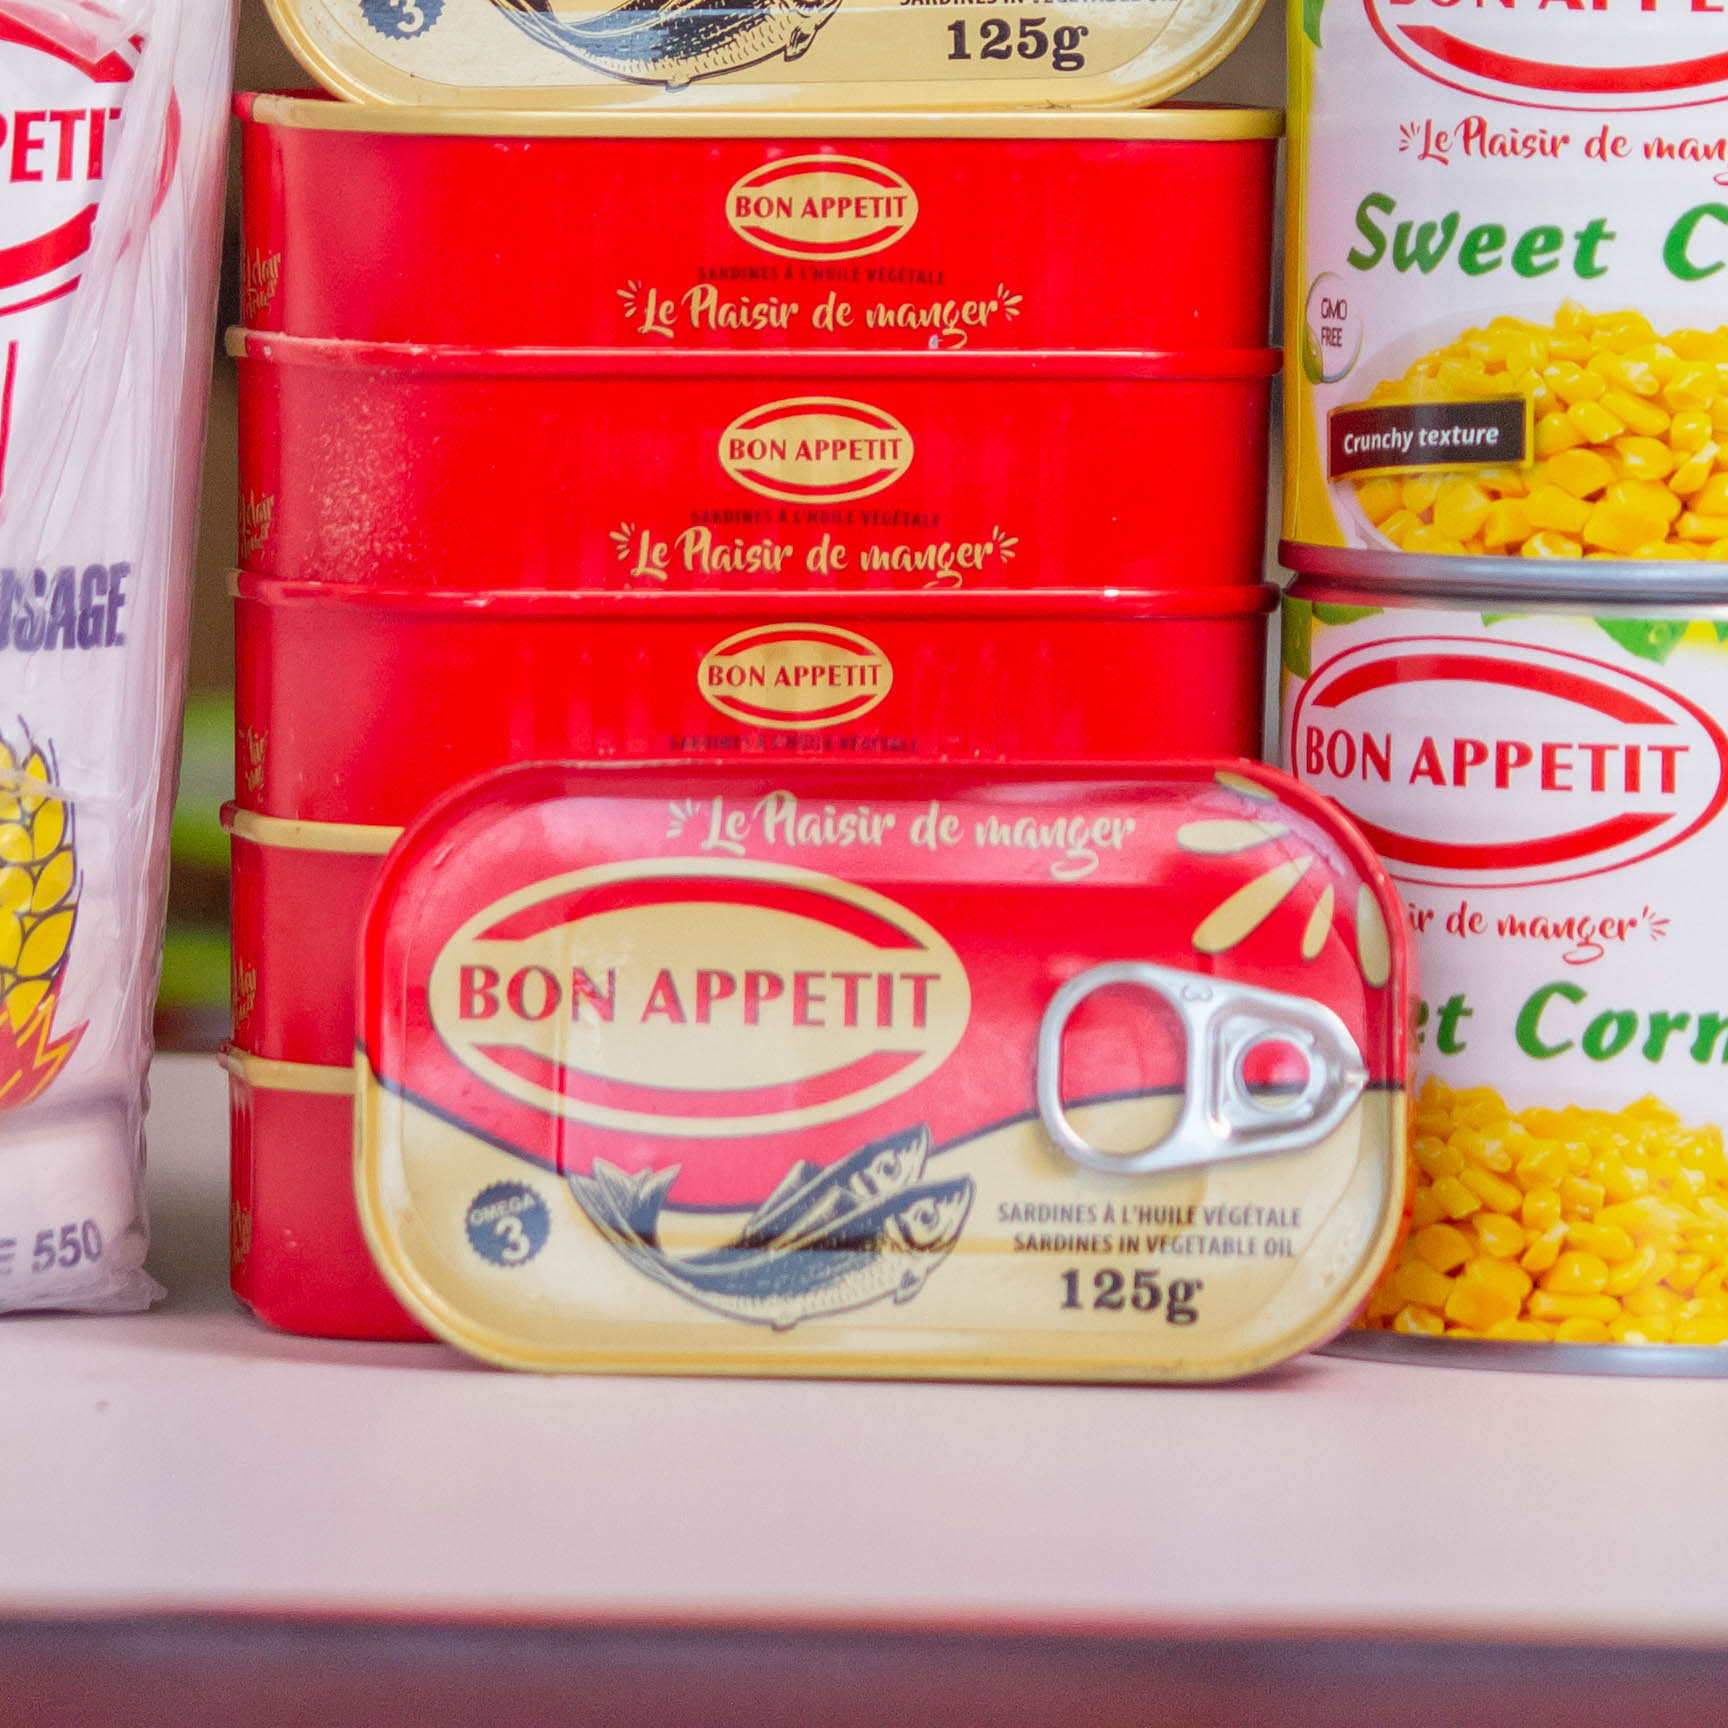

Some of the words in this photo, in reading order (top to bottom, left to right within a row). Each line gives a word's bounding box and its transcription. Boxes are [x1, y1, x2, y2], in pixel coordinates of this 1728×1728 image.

[946, 16, 1089, 72] 125g
[1453, 115, 1570, 159] Plaisir
[1584, 123, 1633, 161] de
[734, 194, 796, 222] BON
[799, 194, 909, 223] APPETIT
[1346, 191, 1617, 280] Sweet
[680, 282, 800, 332] Plaisir
[811, 289, 856, 333] de
[865, 298, 1001, 350] manger
[1320, 297, 1348, 321] GMO
[1320, 325, 1344, 349] FREE
[728, 435, 790, 464] BON
[793, 435, 903, 465] APPETIT
[1343, 426, 1414, 455] Crunchy
[1418, 425, 1500, 447] texture
[674, 526, 794, 576] Plaisir
[805, 531, 852, 576] de
[859, 540, 992, 589] manger
[707, 661, 770, 691] BON
[772, 660, 883, 691] APPETIT
[1304, 724, 1393, 783] BON
[1409, 736, 1690, 795] APPETIT
[752, 791, 895, 848] Plaisir
[910, 801, 964, 848] de
[974, 812, 1137, 881] manger
[1445, 899, 1489, 940] de
[1496, 913, 1639, 966] manger
[458, 966, 618, 1024] BON
[640, 968, 942, 1032] APPETIT
[495, 1215, 531, 1262] 3
[997, 1201, 1097, 1224] SARDINES
[1121, 1204, 1197, 1226] L'HUILE
[1202, 1203, 1303, 1229] VÉGÉTALE
[30, 1216, 103, 1273] 550
[1013, 1231, 1113, 1254] SARDINES
[1118, 1233, 1140, 1254] IN
[1146, 1234, 1257, 1257] VEGETABLE
[1262, 1236, 1298, 1259] OIL
[1060, 1266, 1204, 1327] 125g
